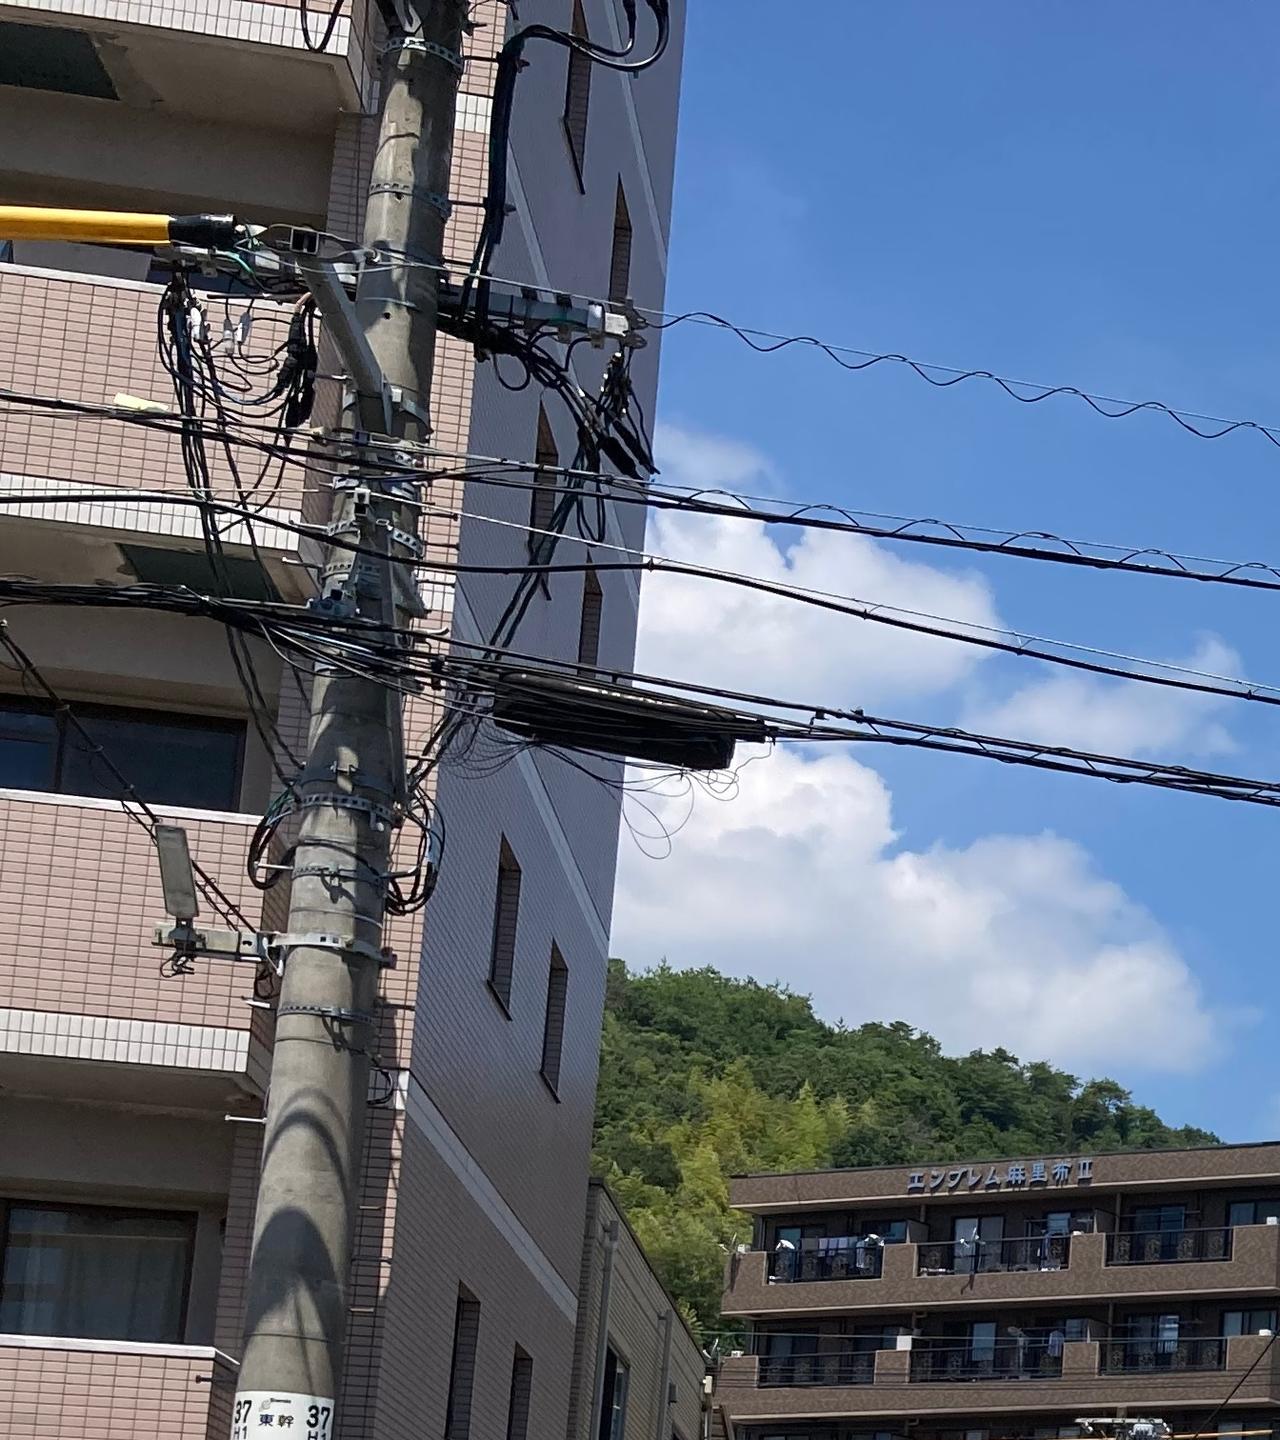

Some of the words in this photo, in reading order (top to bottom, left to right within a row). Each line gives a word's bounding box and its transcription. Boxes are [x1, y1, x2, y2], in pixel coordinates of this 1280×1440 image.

[234, 1399, 252, 1424] 37
[258, 1413, 295, 1429] 東幹
[306, 1404, 331, 1430] 37
[233, 1425, 248, 1440] H1
